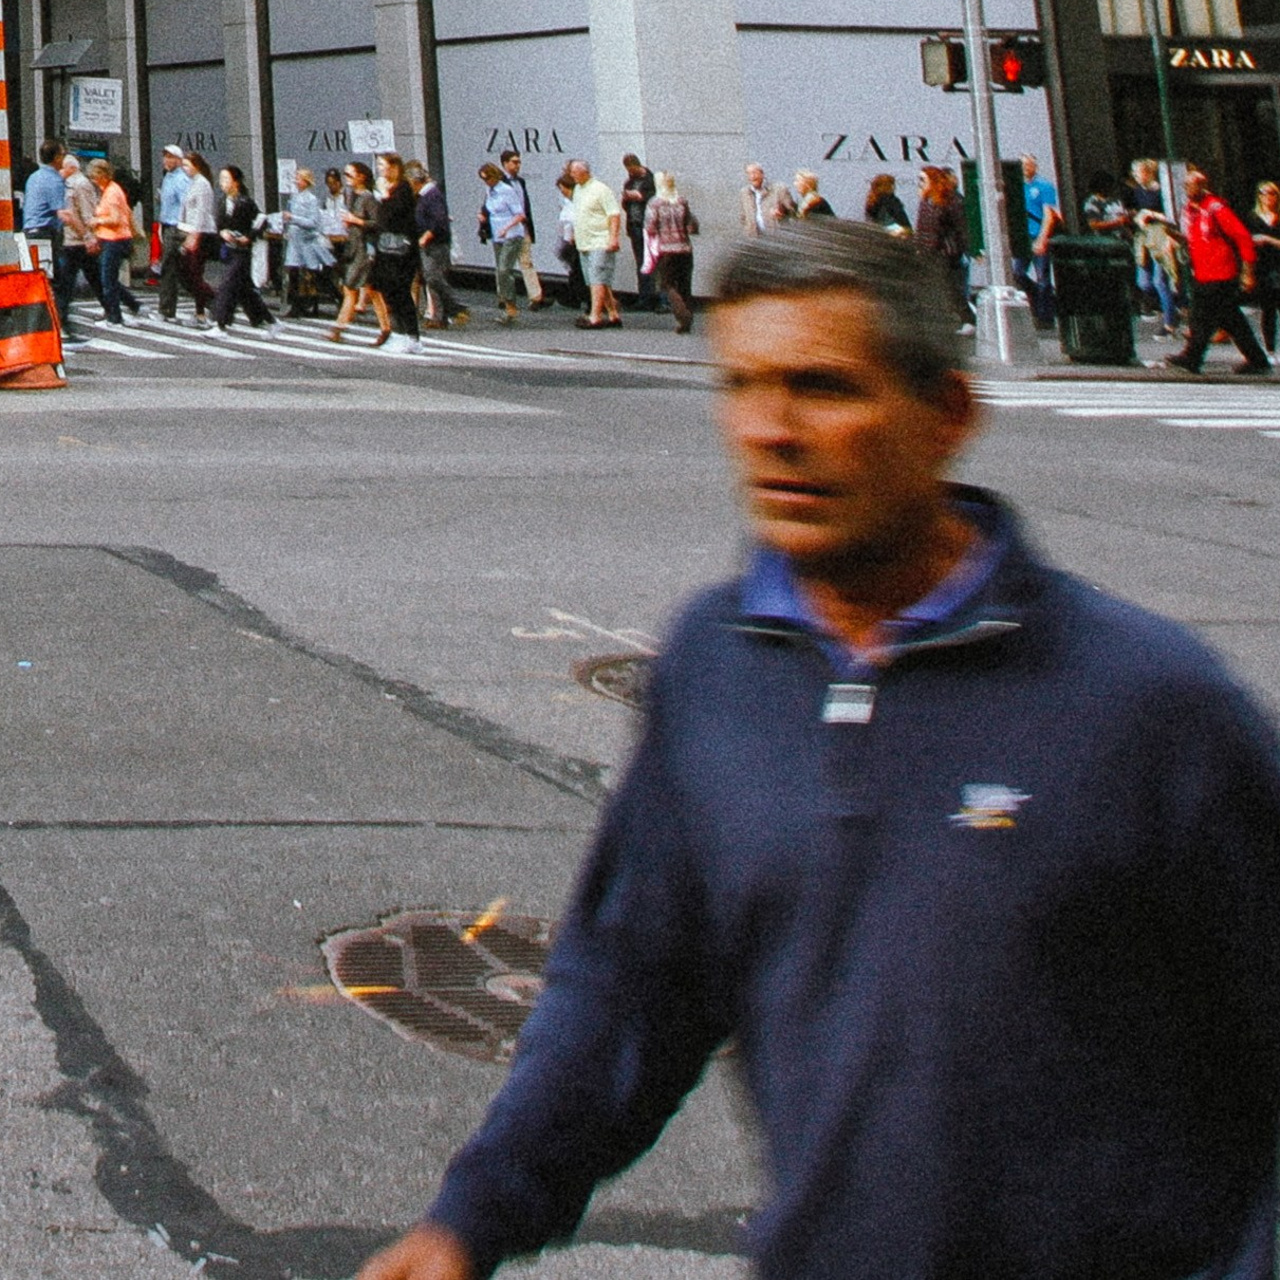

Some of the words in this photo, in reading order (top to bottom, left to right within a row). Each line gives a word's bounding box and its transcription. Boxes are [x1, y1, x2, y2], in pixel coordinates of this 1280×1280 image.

[1168, 47, 1257, 69] ZARA
[174, 131, 218, 152] ZARA
[307, 130, 350, 152] ZAR
[484, 127, 565, 153] ZARA
[821, 134, 970, 162] ZARA
